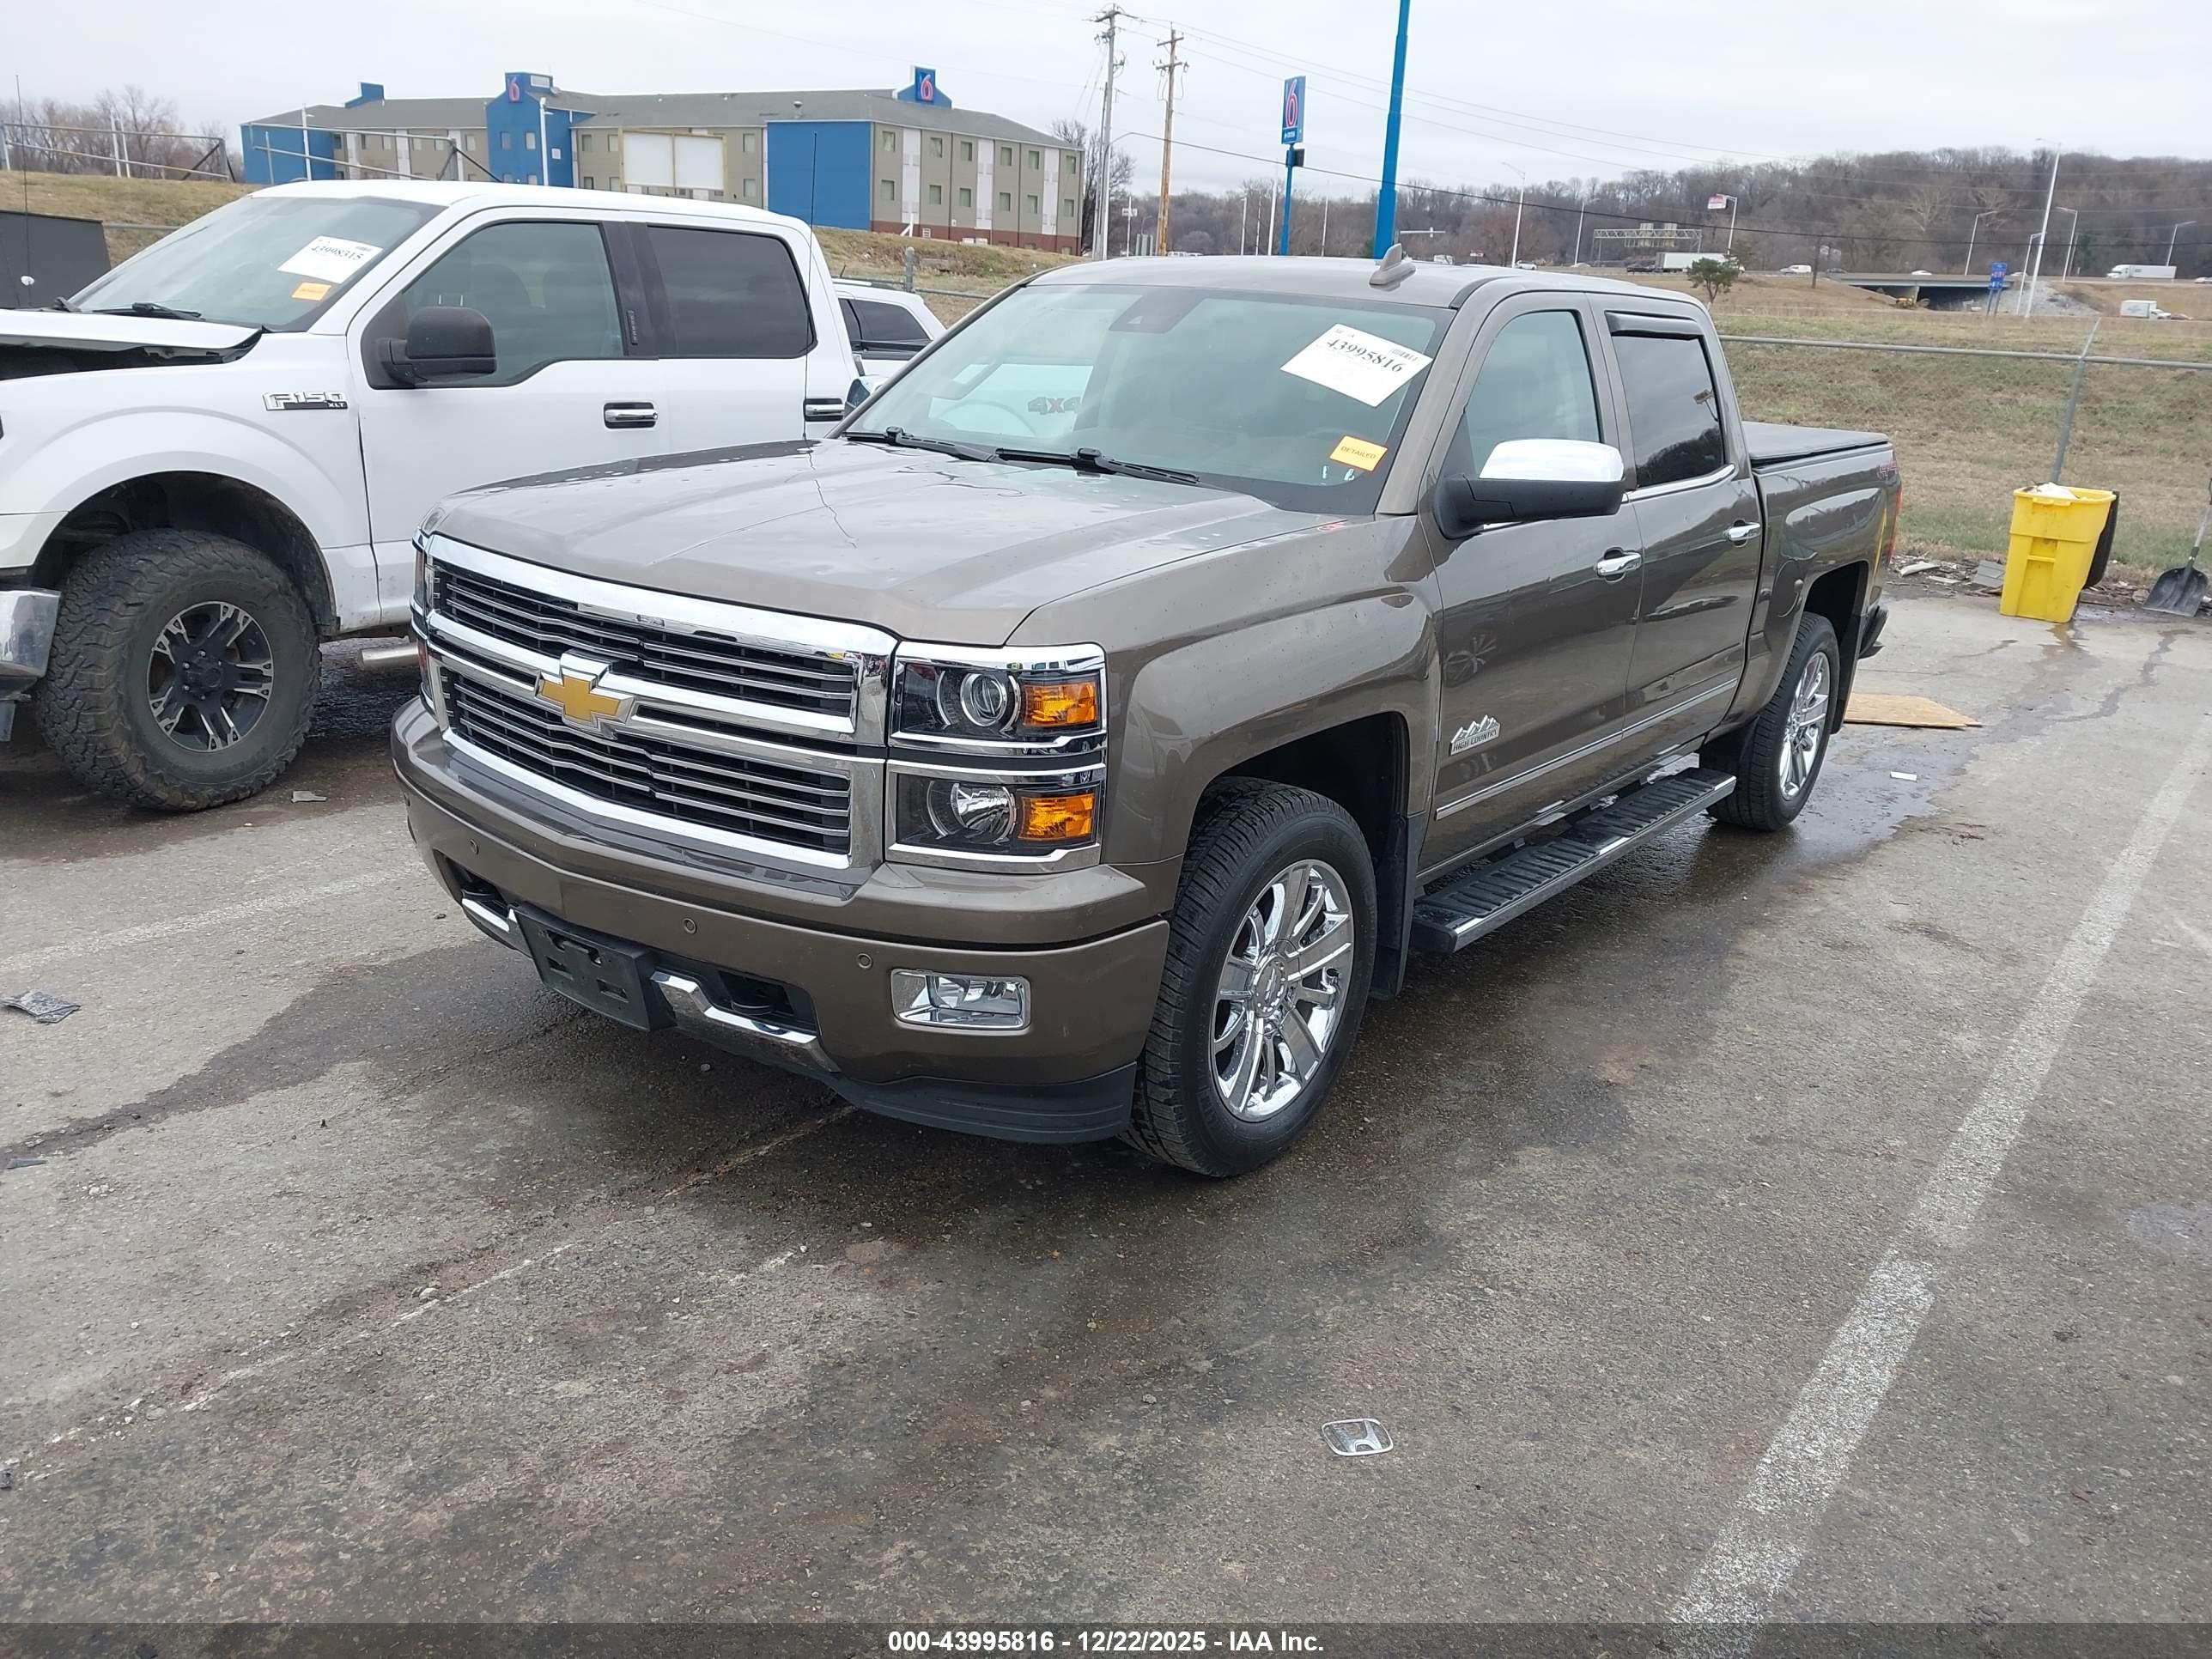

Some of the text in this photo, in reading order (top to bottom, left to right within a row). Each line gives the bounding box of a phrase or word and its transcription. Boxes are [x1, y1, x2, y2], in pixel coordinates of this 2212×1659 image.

[1285, 78, 1298, 128] 6
[1327, 338, 1406, 373] 43995816
[1340, 446, 1376, 459] DETAILED
